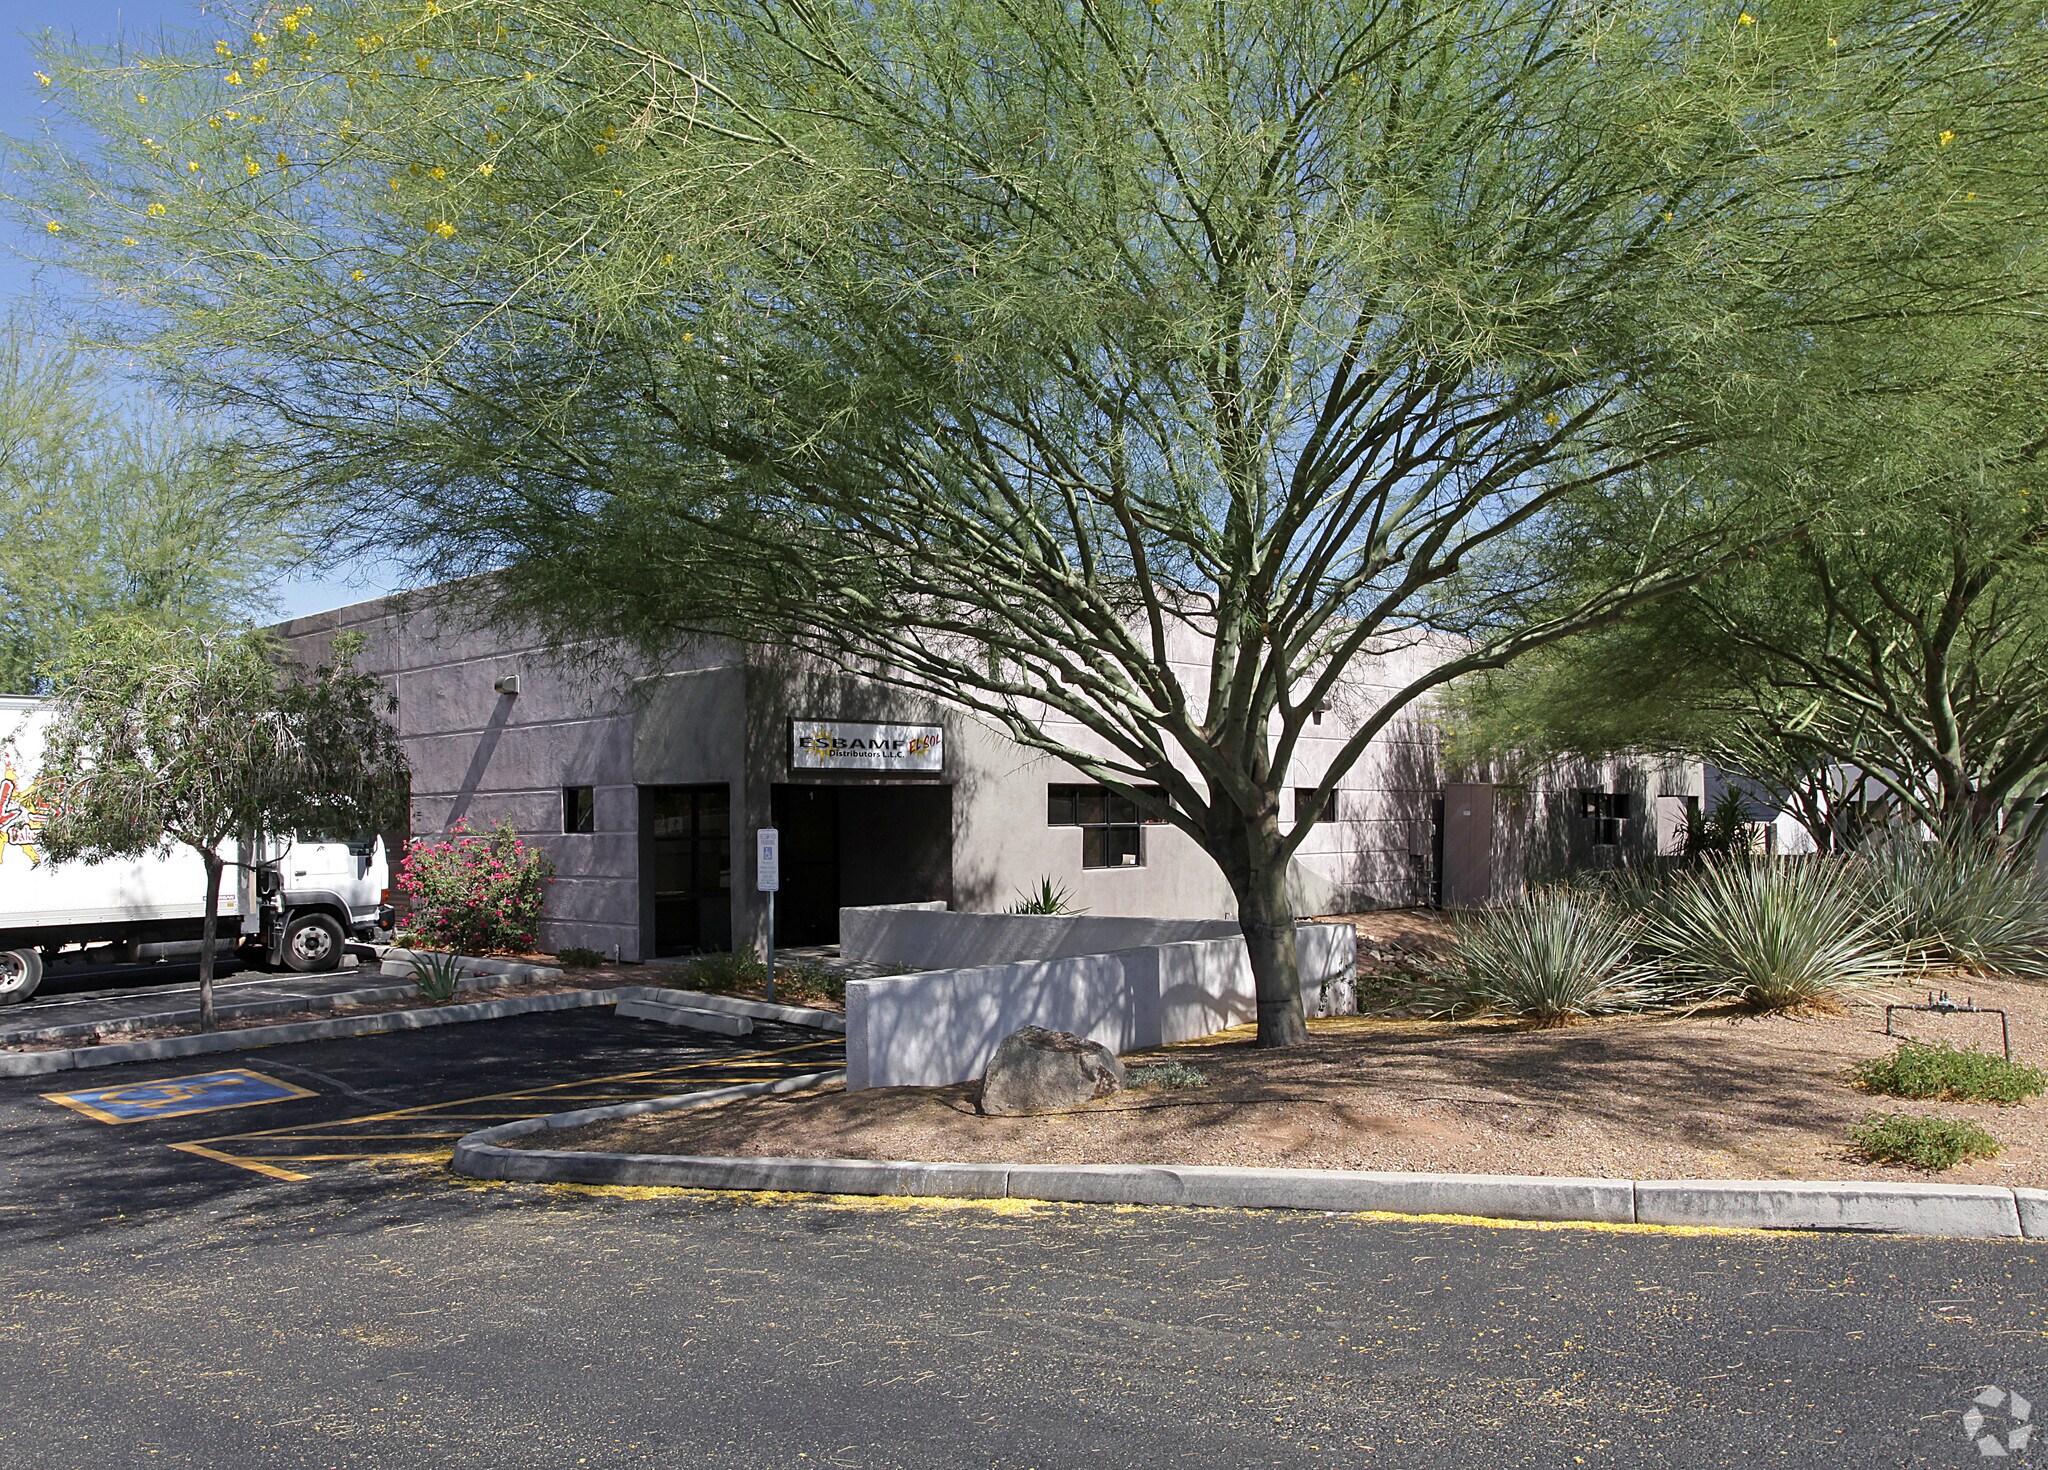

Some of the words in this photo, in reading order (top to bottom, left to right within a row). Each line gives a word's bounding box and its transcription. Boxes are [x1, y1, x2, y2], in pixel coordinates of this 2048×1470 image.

[909, 738, 921, 755] EL
[923, 734, 941, 749] SOL
[829, 749, 880, 758] Distributors
[882, 750, 905, 758] L.L.C.
